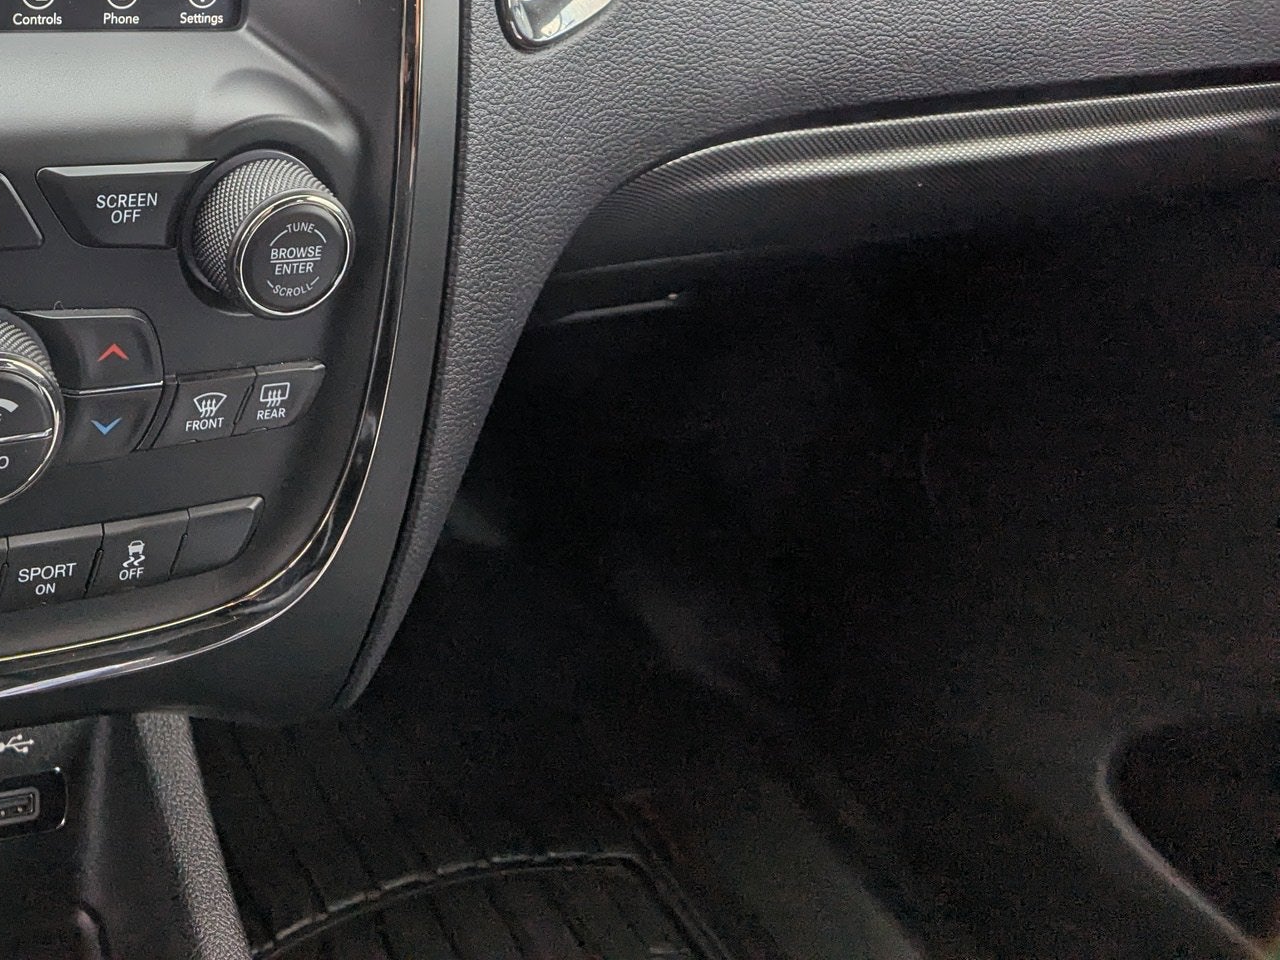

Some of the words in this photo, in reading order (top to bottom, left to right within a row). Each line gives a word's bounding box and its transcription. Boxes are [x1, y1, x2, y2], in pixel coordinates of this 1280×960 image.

[12, 12, 63, 26] Controls
[103, 11, 140, 25] Phone
[179, 11, 224, 26] Settings
[96, 192, 158, 209] SCREEN
[110, 208, 142, 224] OFF
[286, 222, 315, 234] TUNE
[270, 245, 322, 259] BROWSE
[274, 261, 314, 276] ENTER
[272, 283, 314, 297] SCROLL
[256, 406, 286, 421] REAR
[185, 416, 225, 432] FRONT
[17, 562, 77, 583] SPORT
[118, 567, 145, 581] OFF
[35, 582, 56, 596] ON
